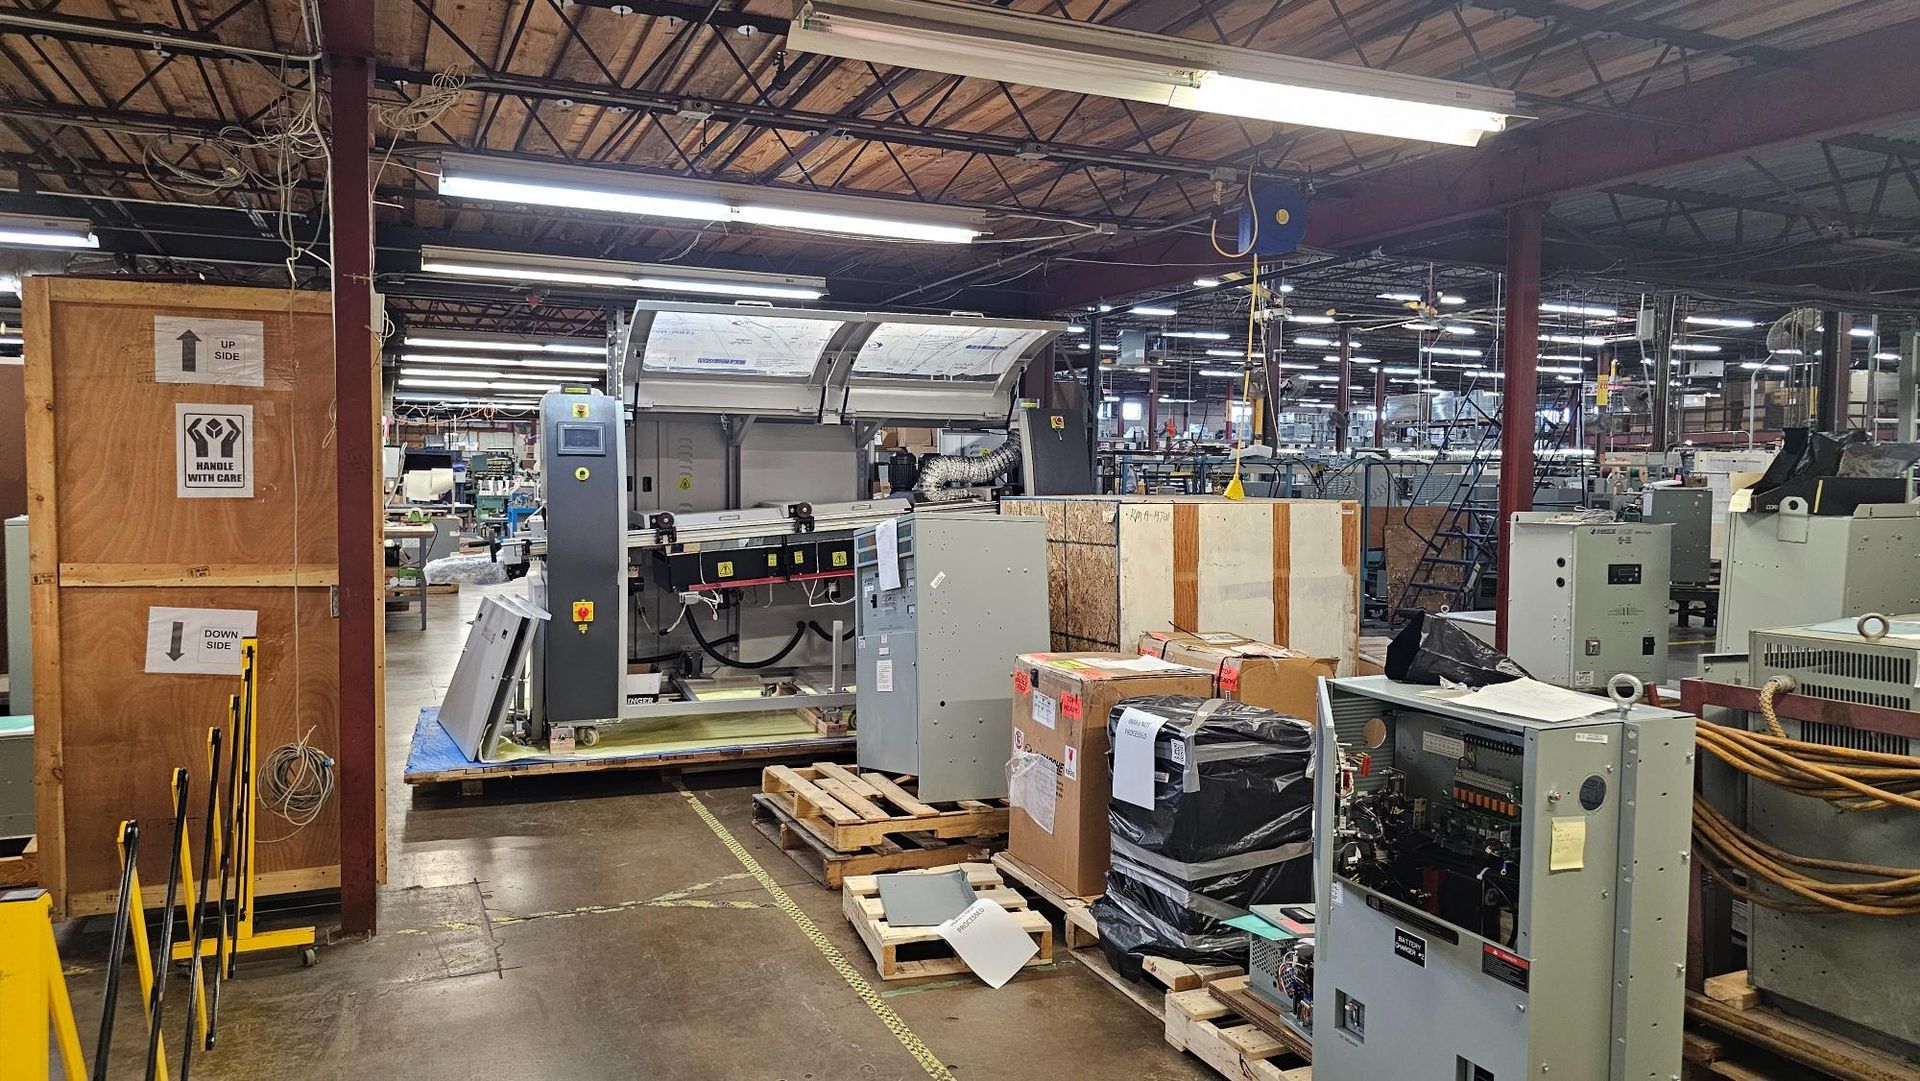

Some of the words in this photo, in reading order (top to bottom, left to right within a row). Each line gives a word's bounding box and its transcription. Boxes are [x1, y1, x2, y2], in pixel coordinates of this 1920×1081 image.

[220, 340, 236, 349] UP
[214, 351, 240, 361] SIDE
[196, 462, 234, 471] HANDLE
[187, 473, 215, 483] WITH
[217, 473, 243, 483] CARE
[204, 629, 239, 639] DOWN
[206, 640, 232, 650] SIDE
[956, 907, 985, 933] PROCESSED
[1397, 935, 1422, 951] BATTERY
[1395, 943, 1417, 957] CHARGER
